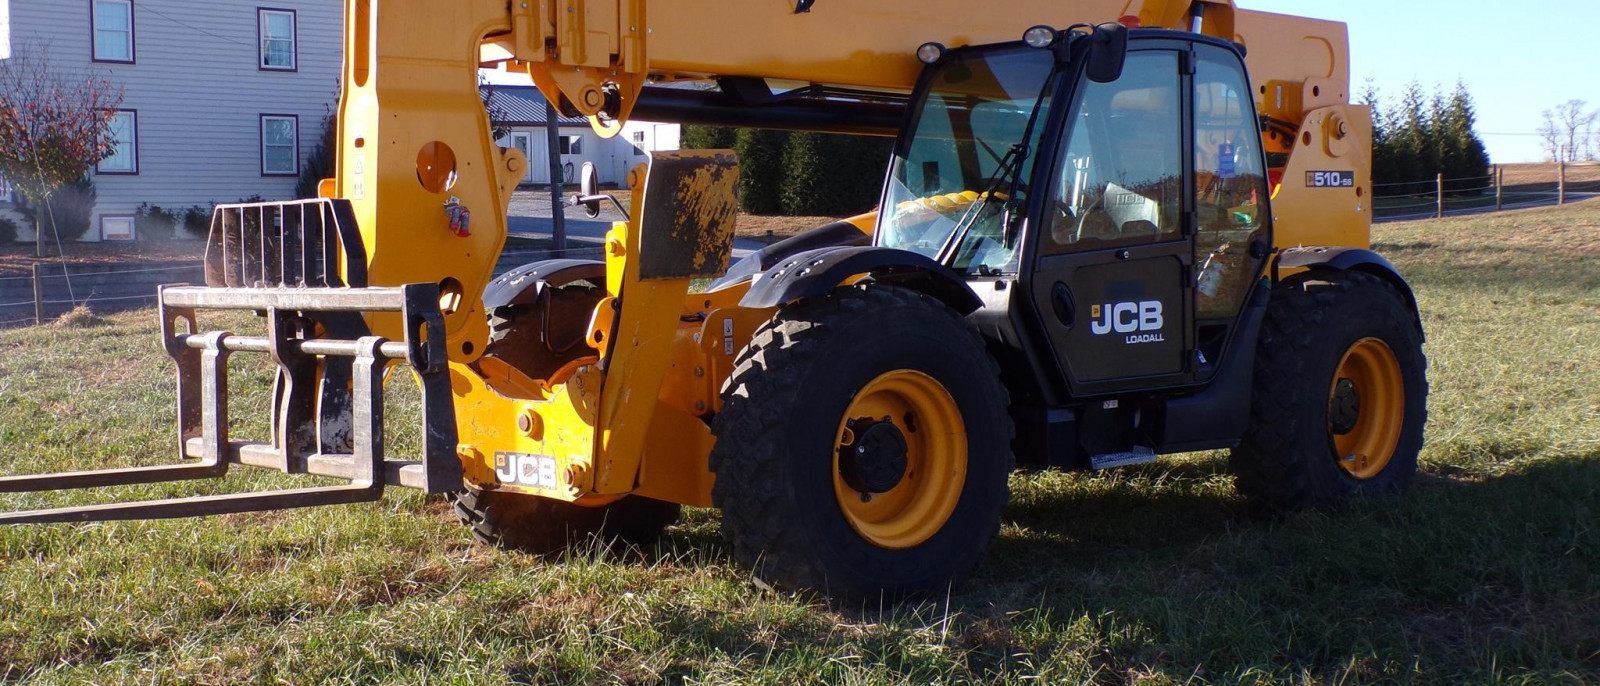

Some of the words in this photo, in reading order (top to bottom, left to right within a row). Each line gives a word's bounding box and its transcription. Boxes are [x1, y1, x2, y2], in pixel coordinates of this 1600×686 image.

[1091, 300, 1163, 335] JCB
[1125, 334, 1165, 344] LOADALL
[496, 454, 556, 487] JCB
